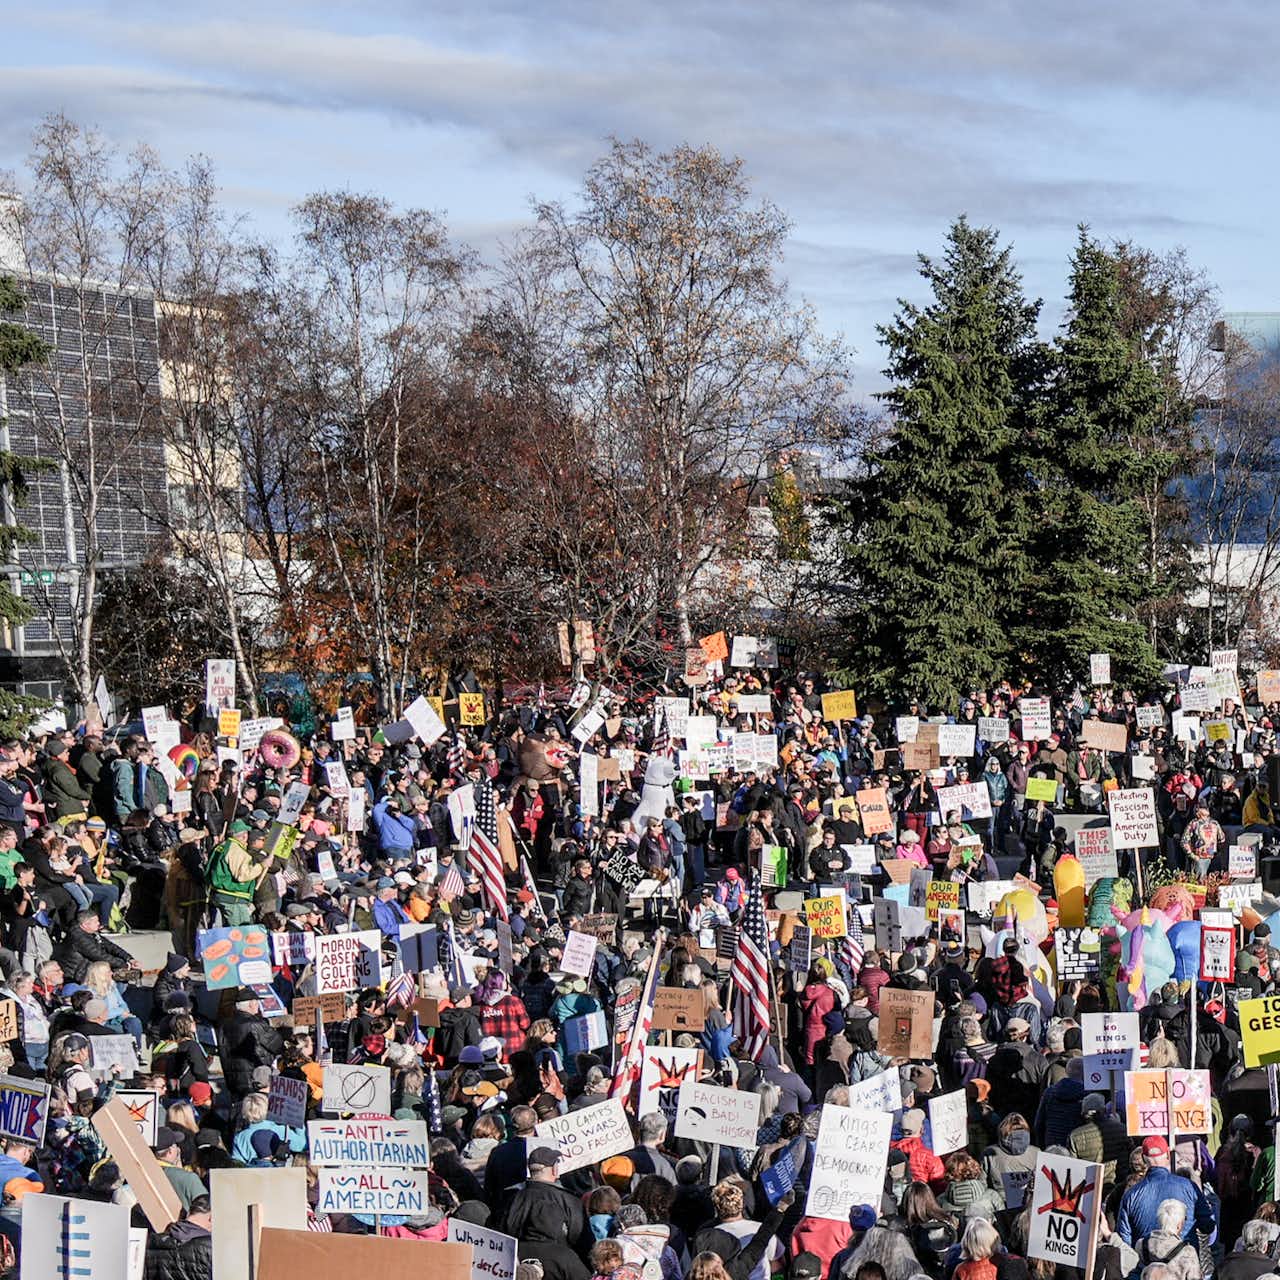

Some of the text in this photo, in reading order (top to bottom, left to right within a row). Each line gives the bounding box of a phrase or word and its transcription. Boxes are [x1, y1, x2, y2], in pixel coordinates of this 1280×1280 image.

[1213, 652, 1237, 665] ANTIFA
[1110, 791, 1148, 802] Protesting
[1114, 803, 1149, 813] Fascism
[1124, 810, 1154, 821] Is Our
[1115, 822, 1153, 832] American
[1078, 830, 1107, 841] THIS
[1124, 831, 1147, 843] Duty
[612, 850, 628, 866] NO
[1079, 845, 1109, 856] DRILL
[931, 883, 953, 893] OUR
[1223, 885, 1256, 899] SAVE
[928, 893, 958, 903] AMERICA
[808, 908, 840, 921] AMERICA
[812, 901, 834, 912] OUR
[819, 917, 832, 925] NO
[815, 925, 842, 938] KINGS
[321, 938, 361, 953] MORON
[321, 951, 368, 967] ABSENT
[321, 963, 371, 980] GOLFING
[1104, 1024, 1117, 1032] NO
[271, 1077, 305, 1102] HANDS
[1149, 1080, 1186, 1100] NO
[694, 1090, 754, 1110] FACISM IS
[549, 1118, 571, 1137] NO
[1139, 1110, 1207, 1129] KING
[345, 1126, 385, 1142] ANTI
[559, 1117, 618, 1149] NO WARS
[313, 1141, 427, 1166] AUTHORITARIAN
[560, 1147, 583, 1163] NO
[816, 1158, 883, 1185] DEMOCRACY
[360, 1175, 390, 1191] ALL
[323, 1191, 422, 1214] AMERICAN
[1046, 1215, 1079, 1243] NO
[456, 1229, 504, 1252] What Did
[1045, 1240, 1077, 1257] KINGS
